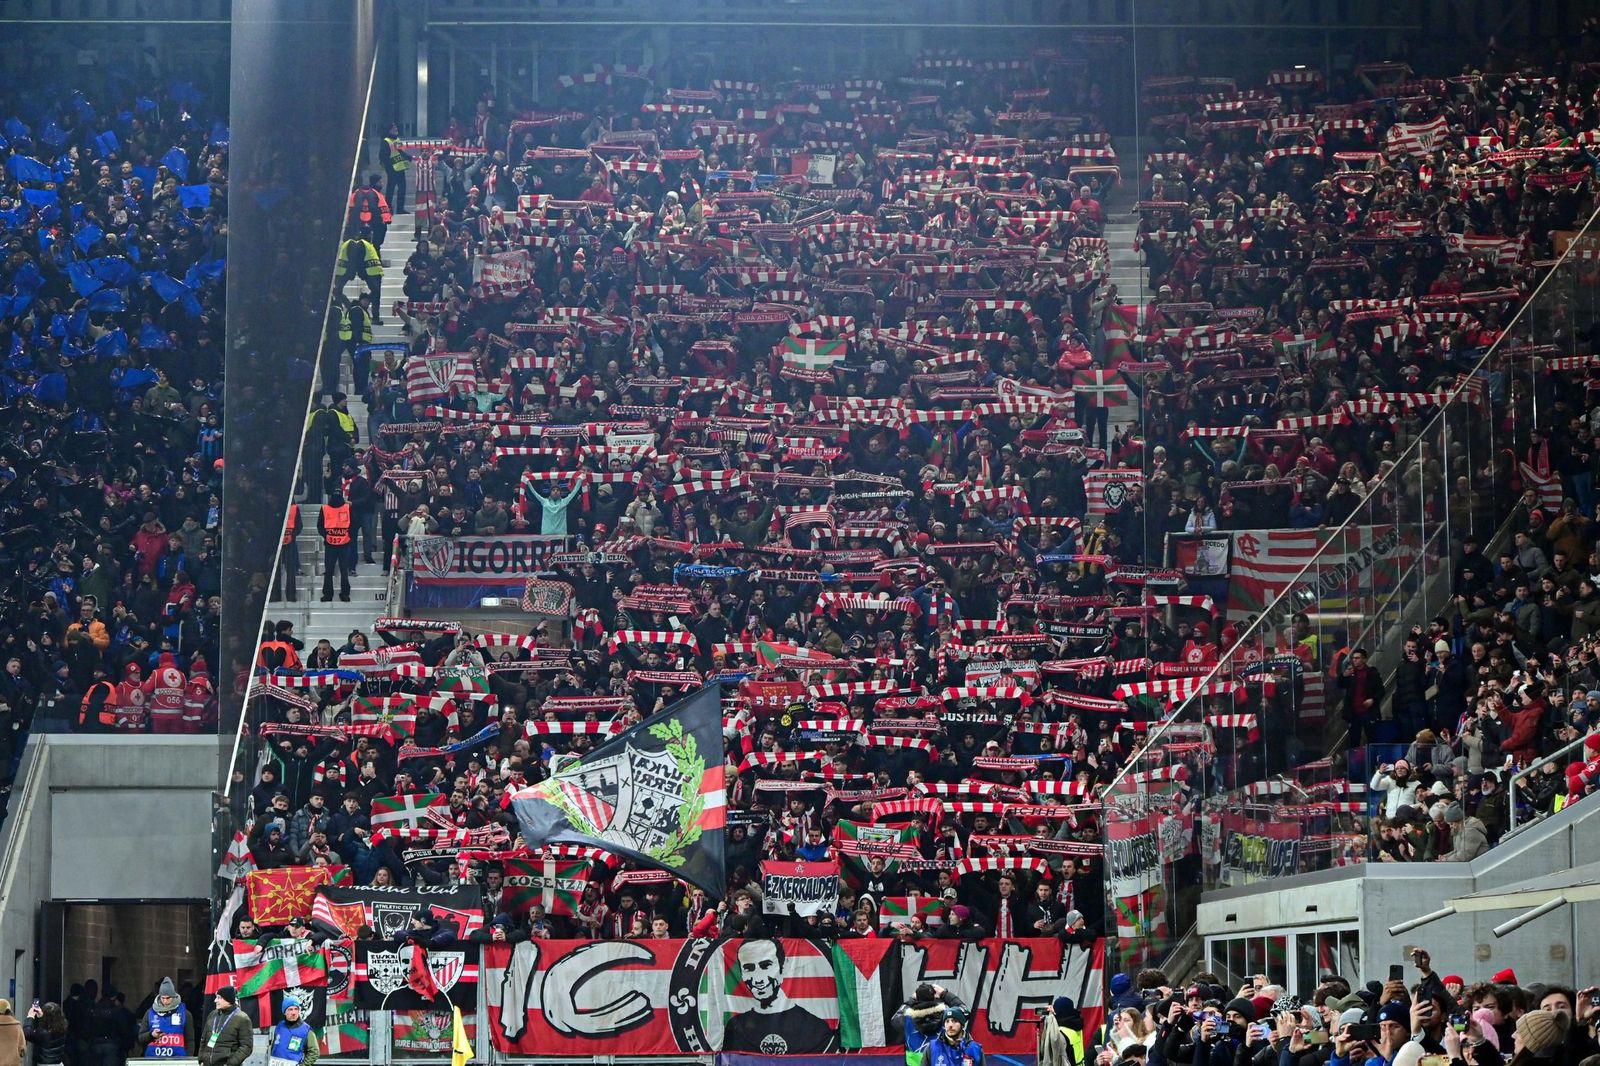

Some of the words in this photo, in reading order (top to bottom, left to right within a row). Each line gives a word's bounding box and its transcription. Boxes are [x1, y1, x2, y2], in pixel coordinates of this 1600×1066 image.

[166, 696, 180, 704] 056
[939, 712, 998, 723] JUSTIZIA
[508, 876, 584, 892] COSENZA
[764, 873, 840, 903] EZKERRALDEA
[375, 903, 401, 911] ATHLETIC
[154, 1046, 174, 1057] 020
